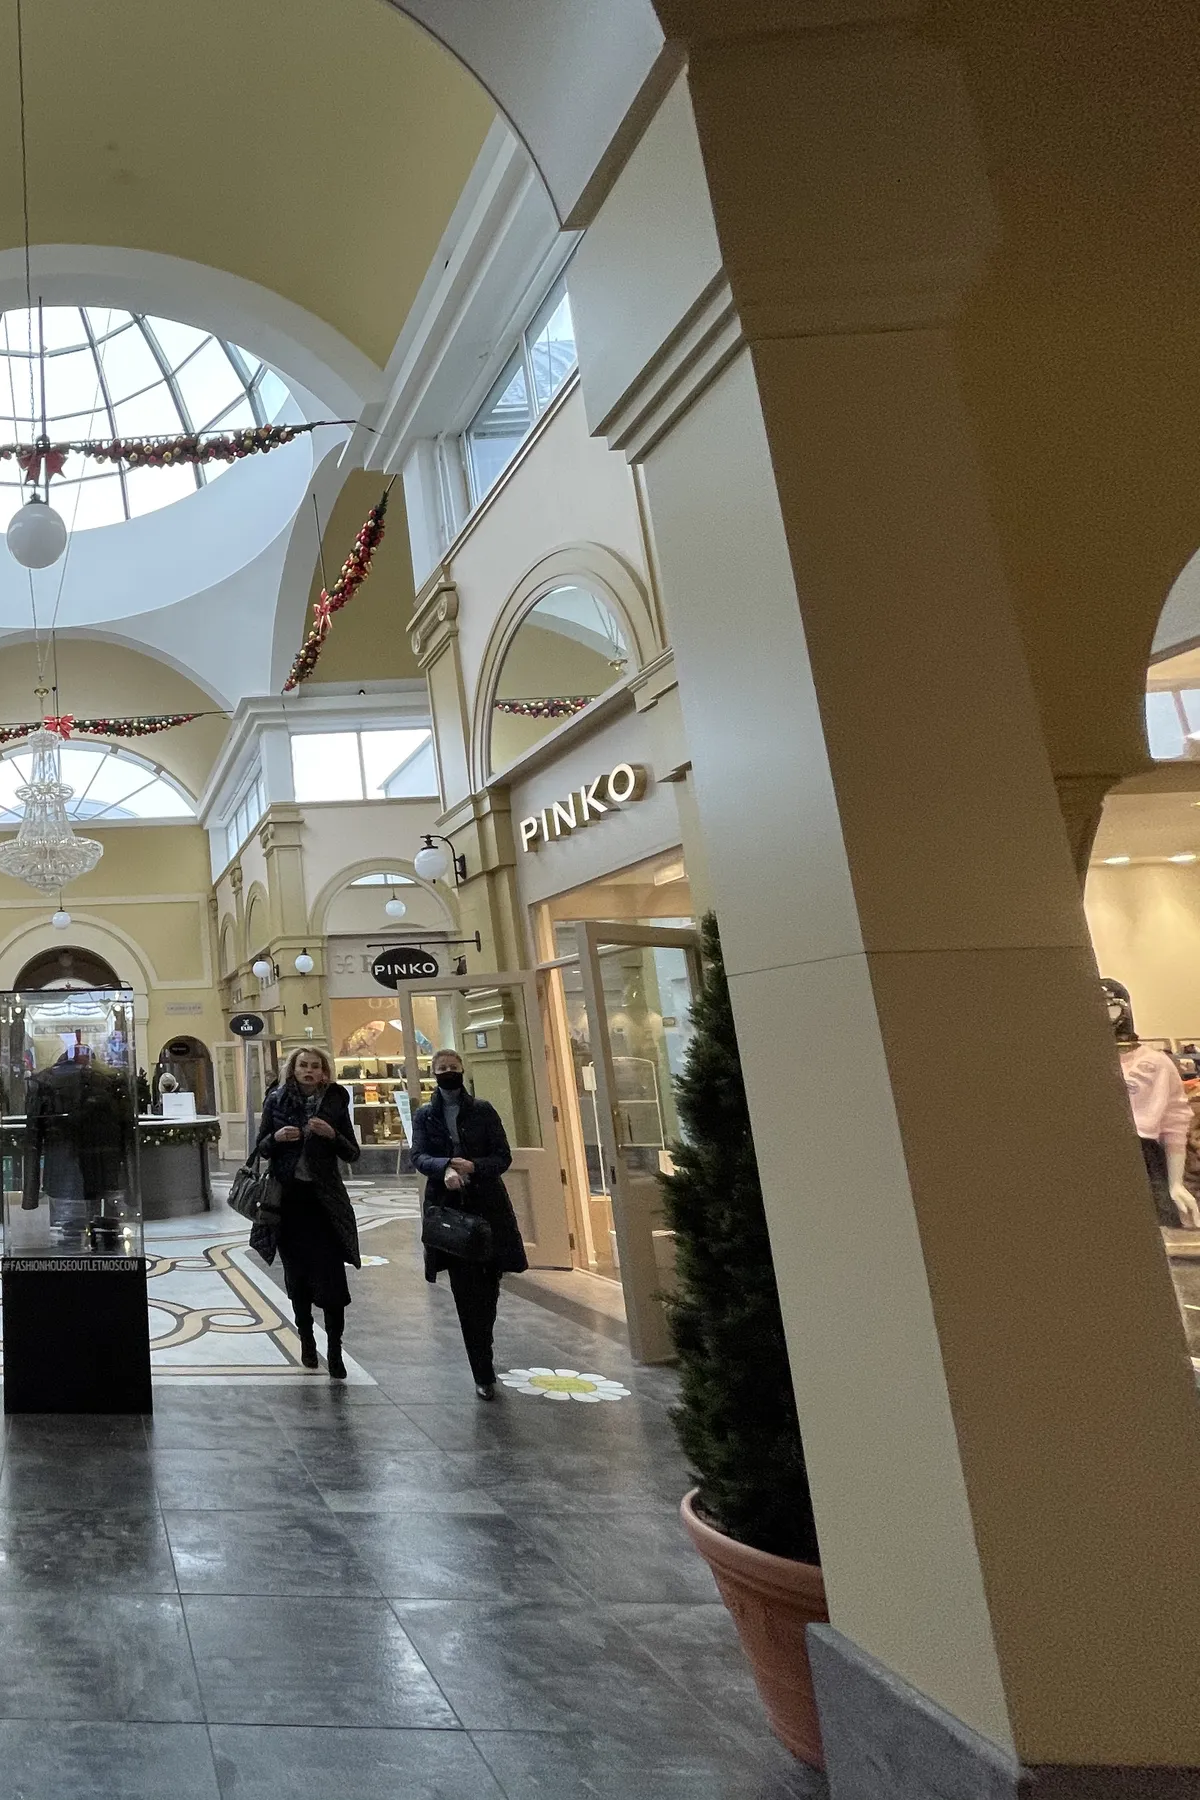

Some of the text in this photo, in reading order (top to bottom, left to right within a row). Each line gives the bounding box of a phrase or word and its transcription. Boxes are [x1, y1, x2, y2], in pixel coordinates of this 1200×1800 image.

[520, 763, 635, 852] PINKO
[374, 962, 436, 976] PINKO
[3, 1260, 139, 1272] #FASHIONHOUSEOUTLETMOSCOW
